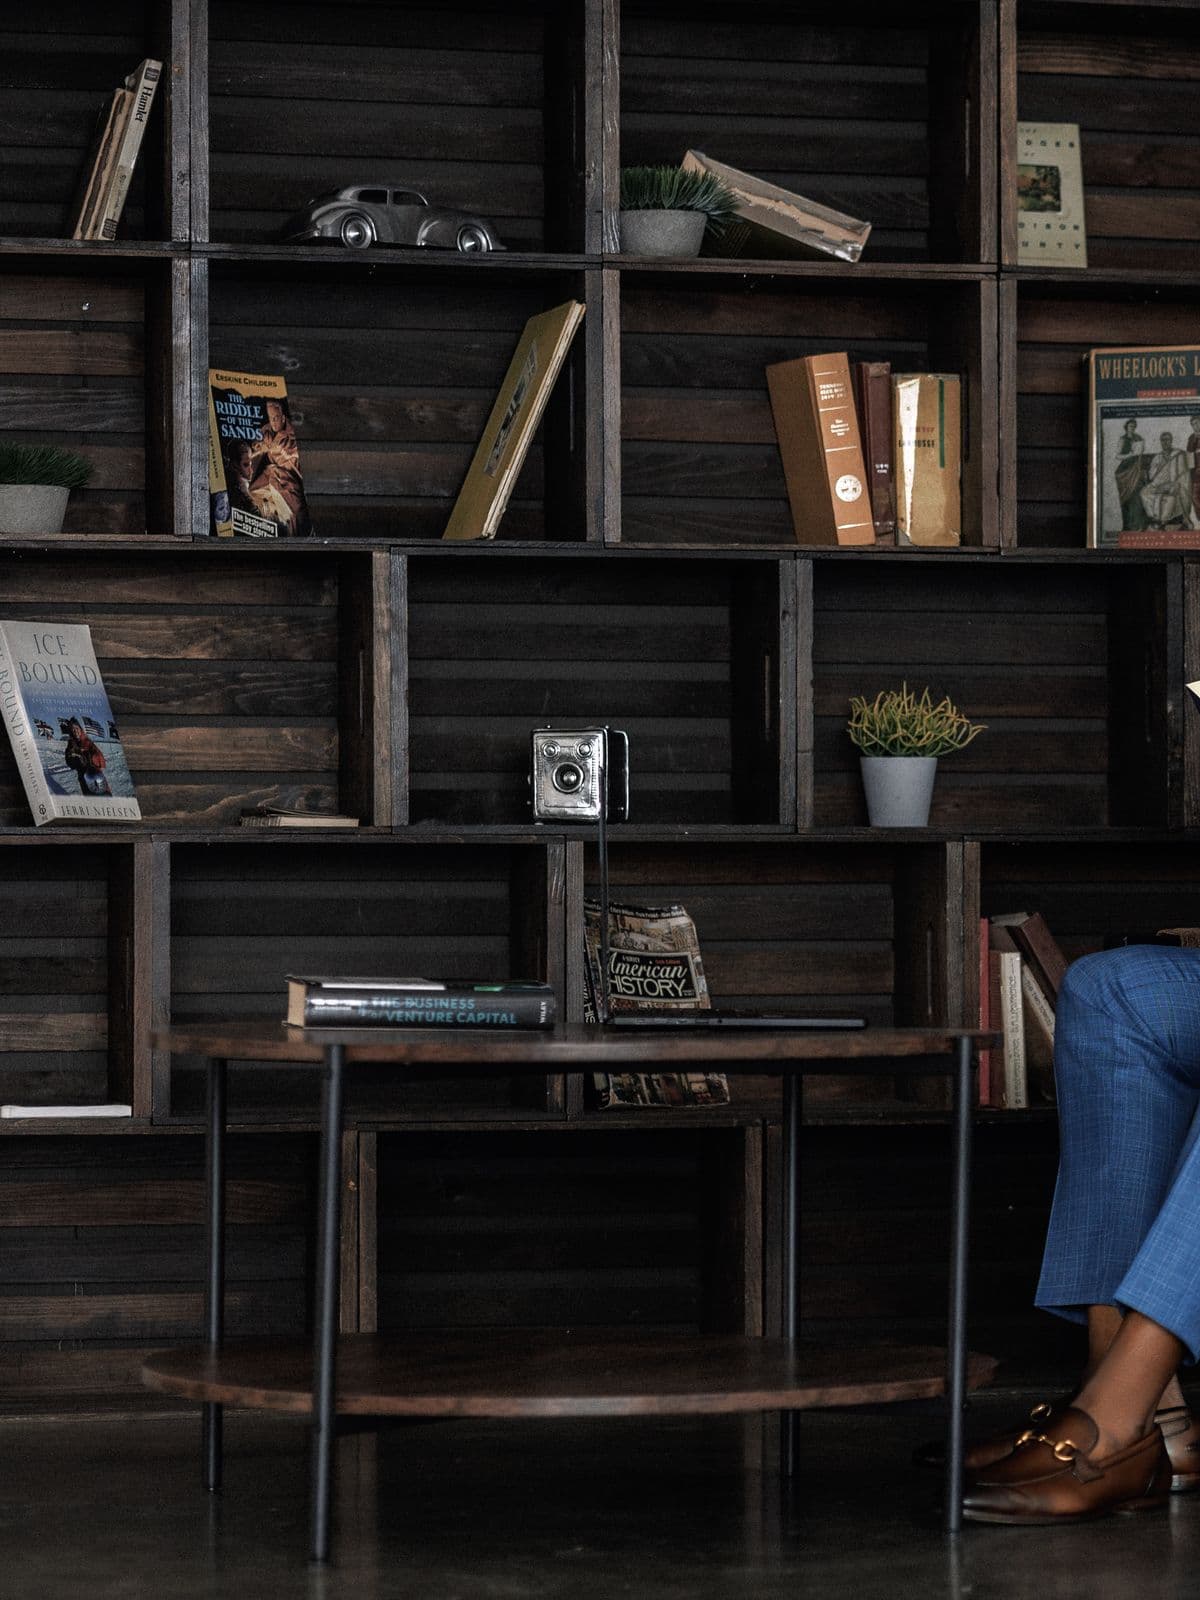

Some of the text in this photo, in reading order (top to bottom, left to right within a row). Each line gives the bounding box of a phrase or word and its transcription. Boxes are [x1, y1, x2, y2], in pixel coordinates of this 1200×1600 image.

[135, 86, 153, 122] Hamlet
[1100, 354, 1187, 379] WHEELOCK'S
[215, 373, 278, 387] ERSKINE CHILDERS
[228, 393, 245, 404] THE
[215, 400, 264, 419] RIDDLE
[227, 416, 254, 426] OF THE
[221, 423, 263, 441] SANDS
[234, 511, 276, 534] The bestselling
[33, 633, 69, 656] ICE
[19, 661, 97, 686] BOUND
[61, 805, 90, 817] JERRI
[93, 805, 138, 817] NIELSEN
[608, 952, 688, 979] American
[608, 976, 687, 998] HISTORY
[405, 998, 476, 1010] BUSINESS
[539, 1001, 547, 1024] WILEY
[385, 1012, 452, 1024] VENTURE
[457, 1012, 518, 1024] CAPITAL
